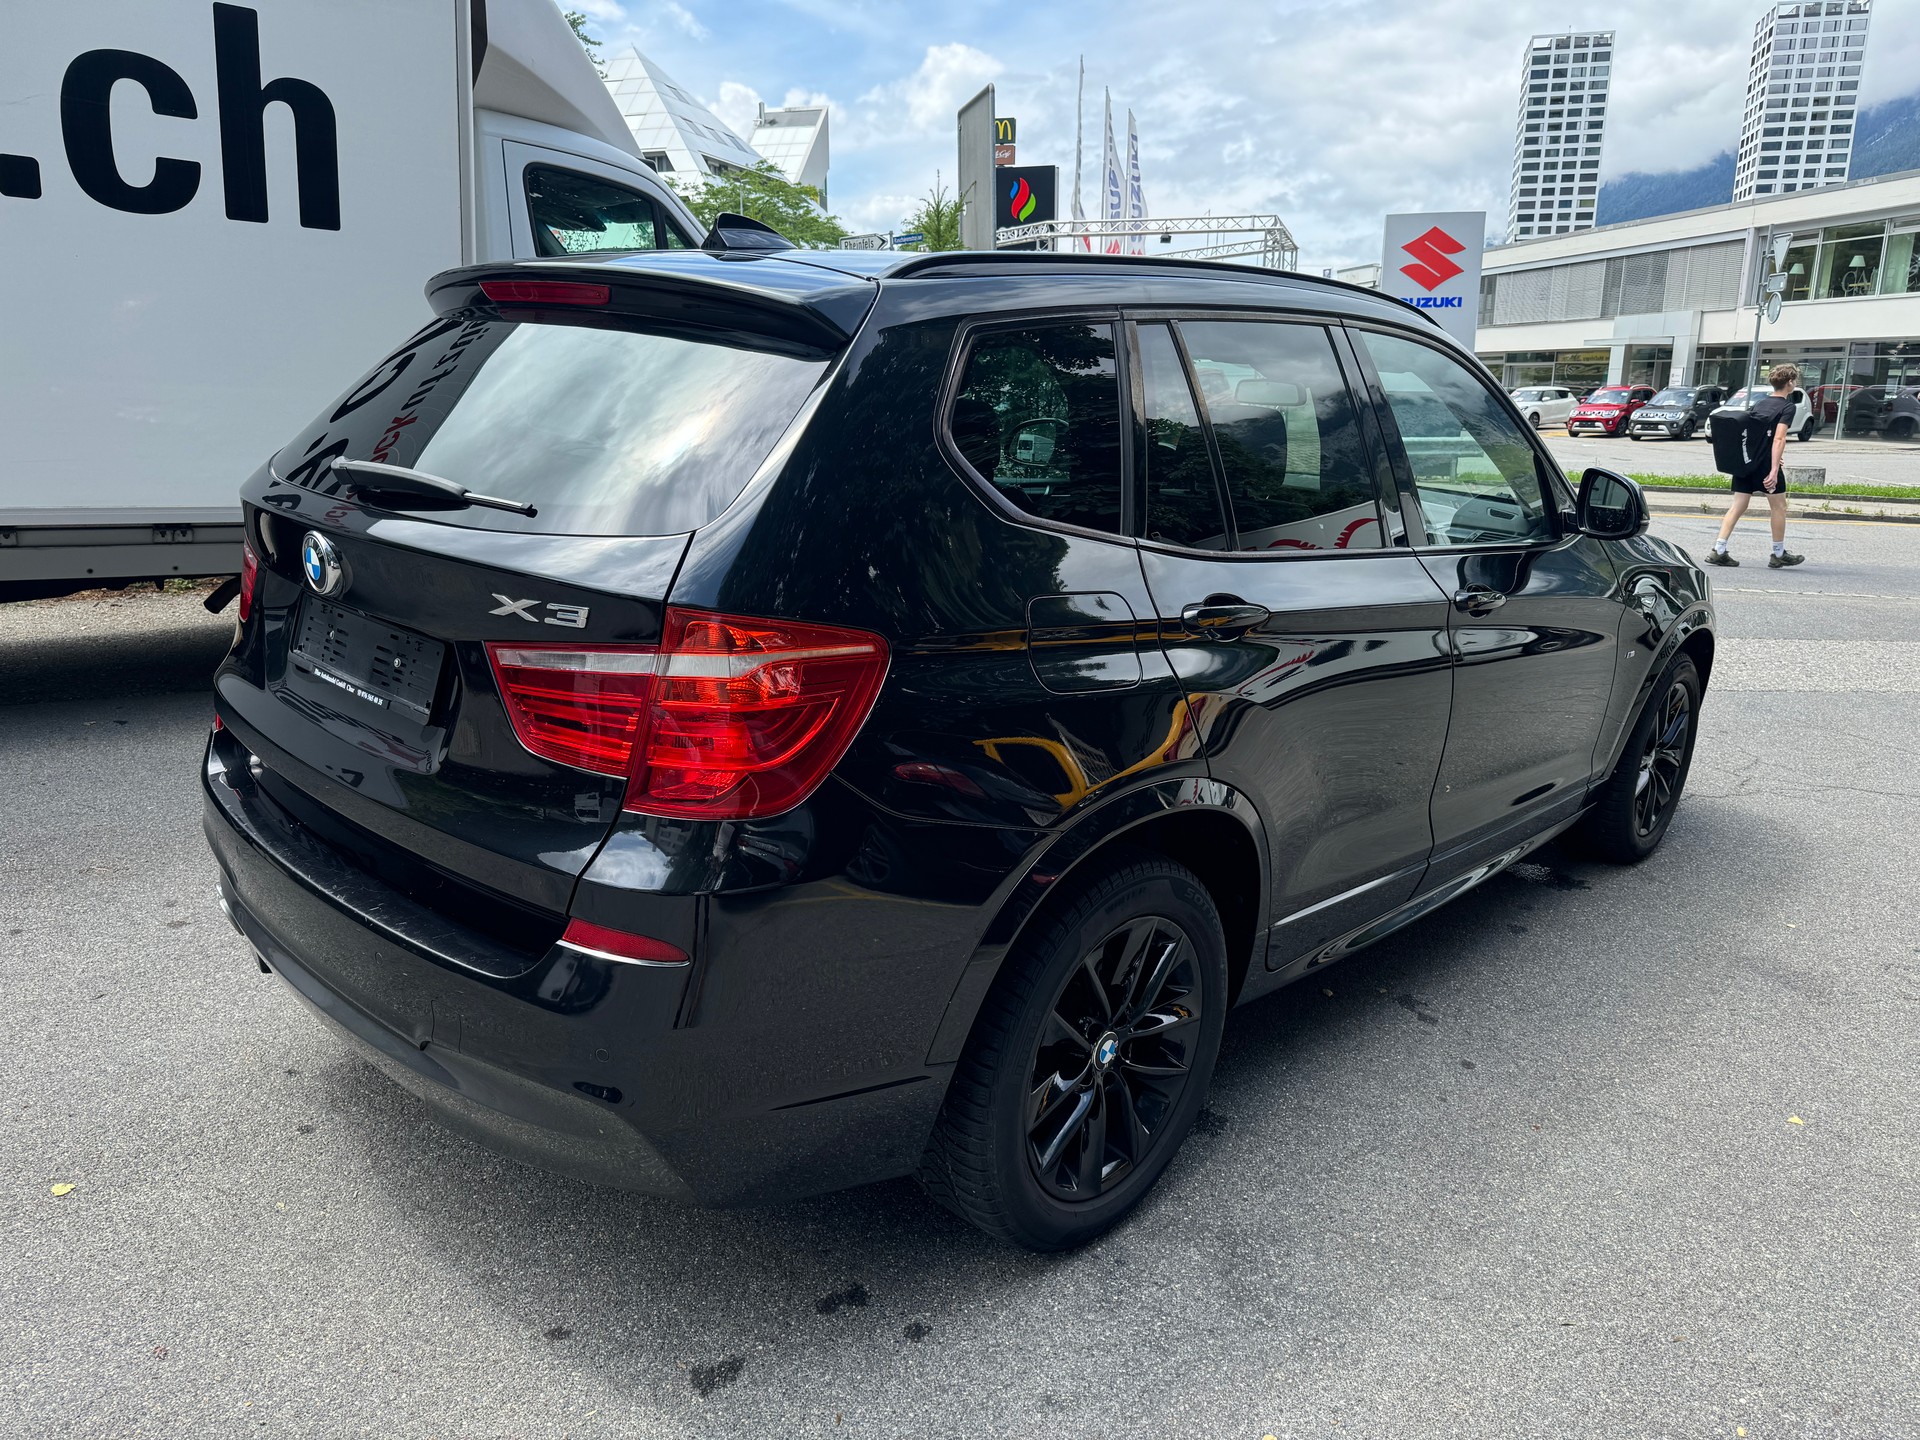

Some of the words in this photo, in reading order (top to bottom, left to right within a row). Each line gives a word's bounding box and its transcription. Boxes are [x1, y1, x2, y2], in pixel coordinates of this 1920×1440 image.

[0, 2, 341, 231] .ch
[844, 238, 874, 250] Rheinfels
[488, 592, 590, 629] X3
